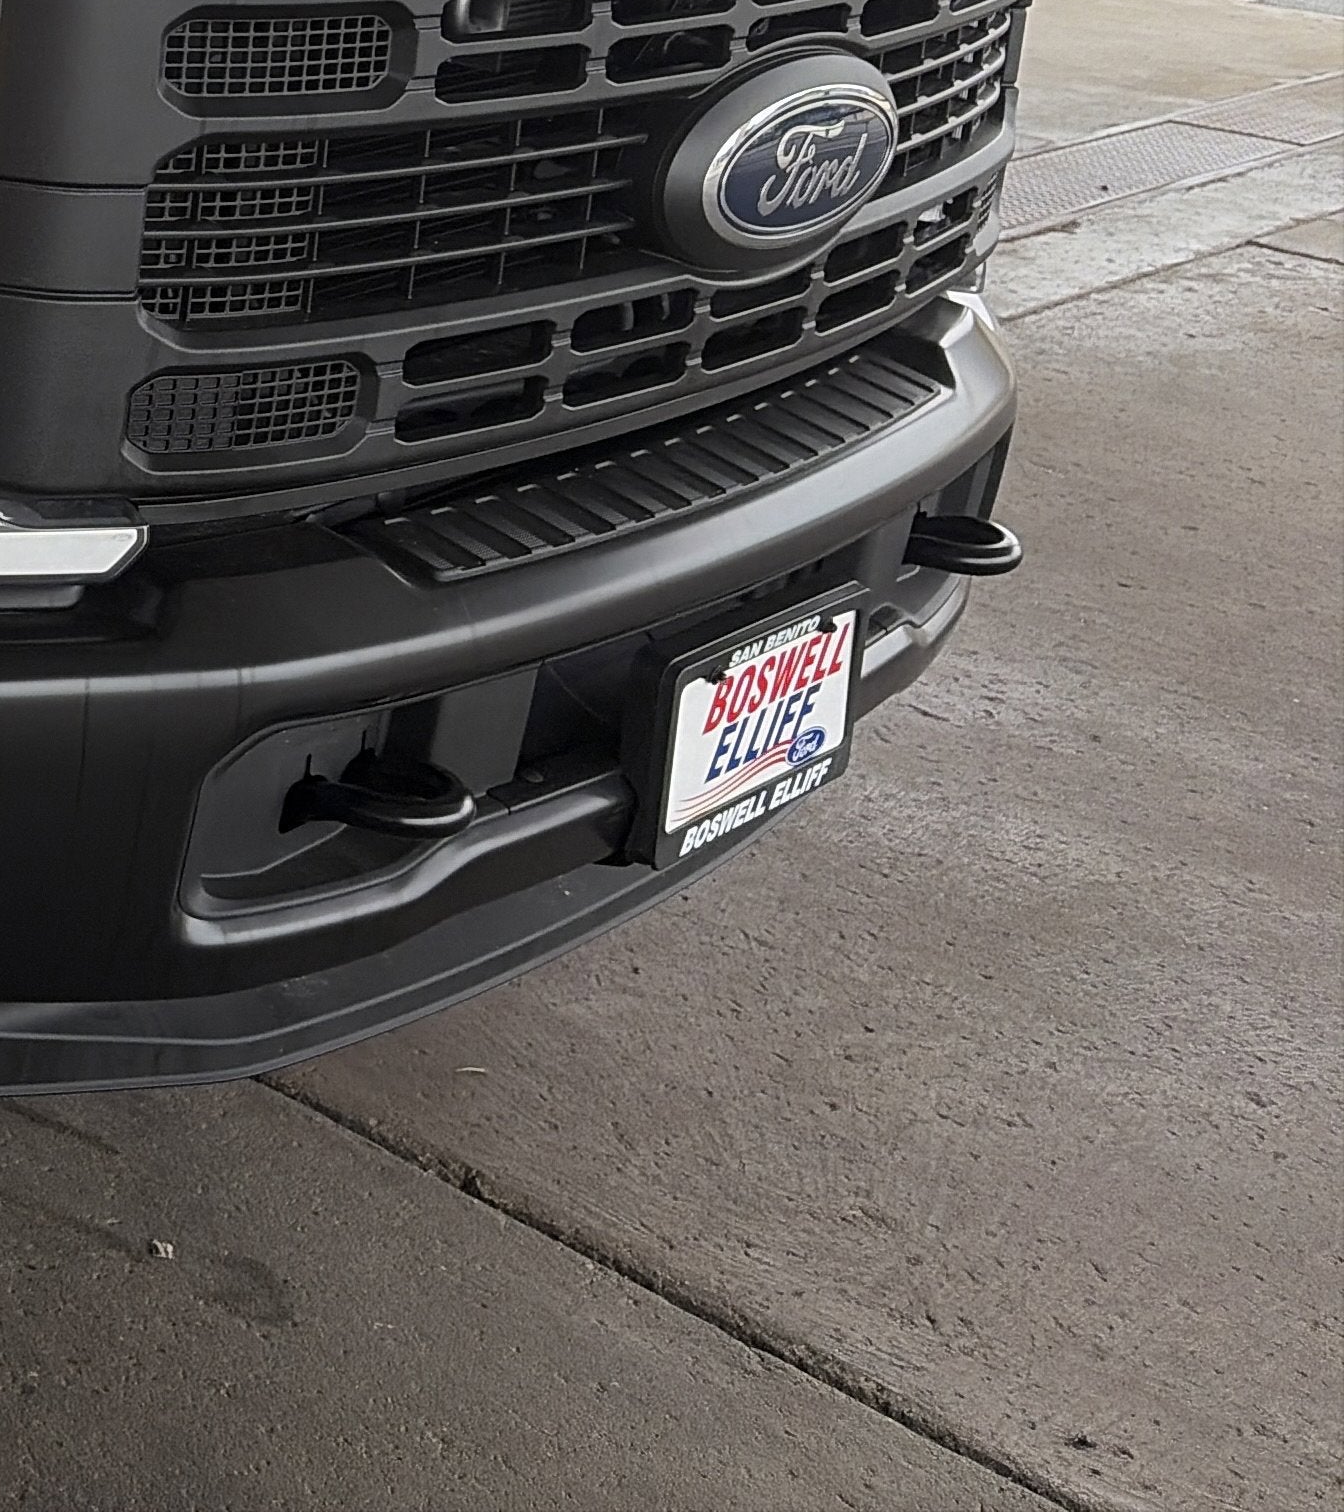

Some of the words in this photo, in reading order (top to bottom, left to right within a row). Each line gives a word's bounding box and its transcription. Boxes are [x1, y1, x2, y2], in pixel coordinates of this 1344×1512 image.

[757, 119, 869, 216] Ford
[702, 622, 851, 735] BOSWELL
[729, 640, 765, 668] SAN
[763, 615, 821, 653] BENITO
[704, 682, 823, 784] ELLIFF
[791, 730, 824, 761] Ford
[678, 790, 766, 858] BOSWELL
[768, 757, 833, 809] ELLIFF
